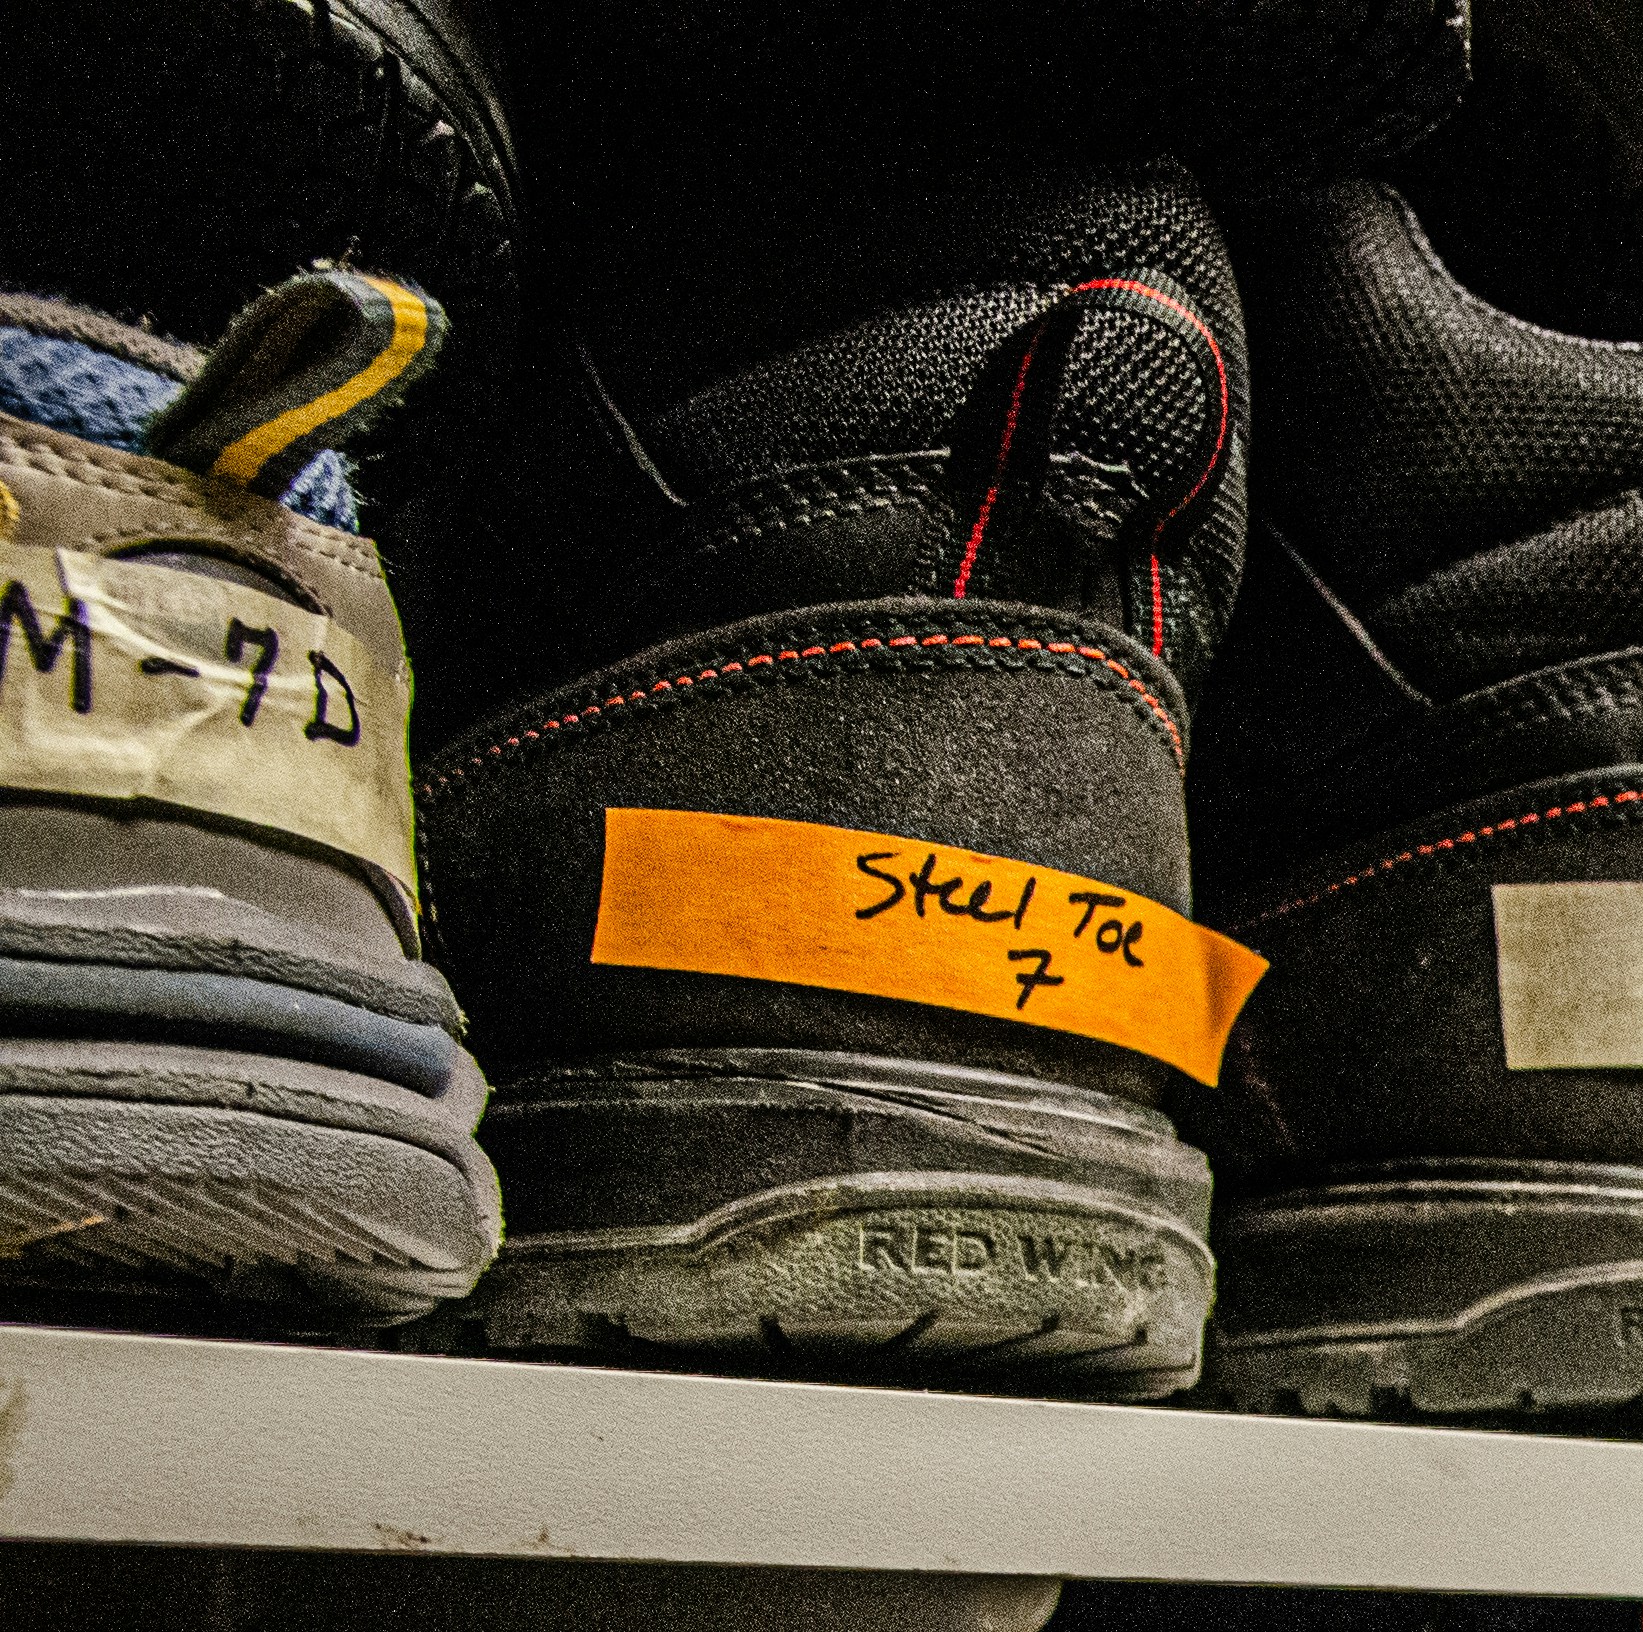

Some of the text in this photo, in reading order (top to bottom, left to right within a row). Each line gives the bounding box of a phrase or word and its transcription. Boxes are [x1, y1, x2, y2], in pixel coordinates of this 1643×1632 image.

[855, 851, 1144, 968] Steel Toe
[1006, 948, 1065, 1010] 7
[857, 1222, 1170, 1291] RED WING
